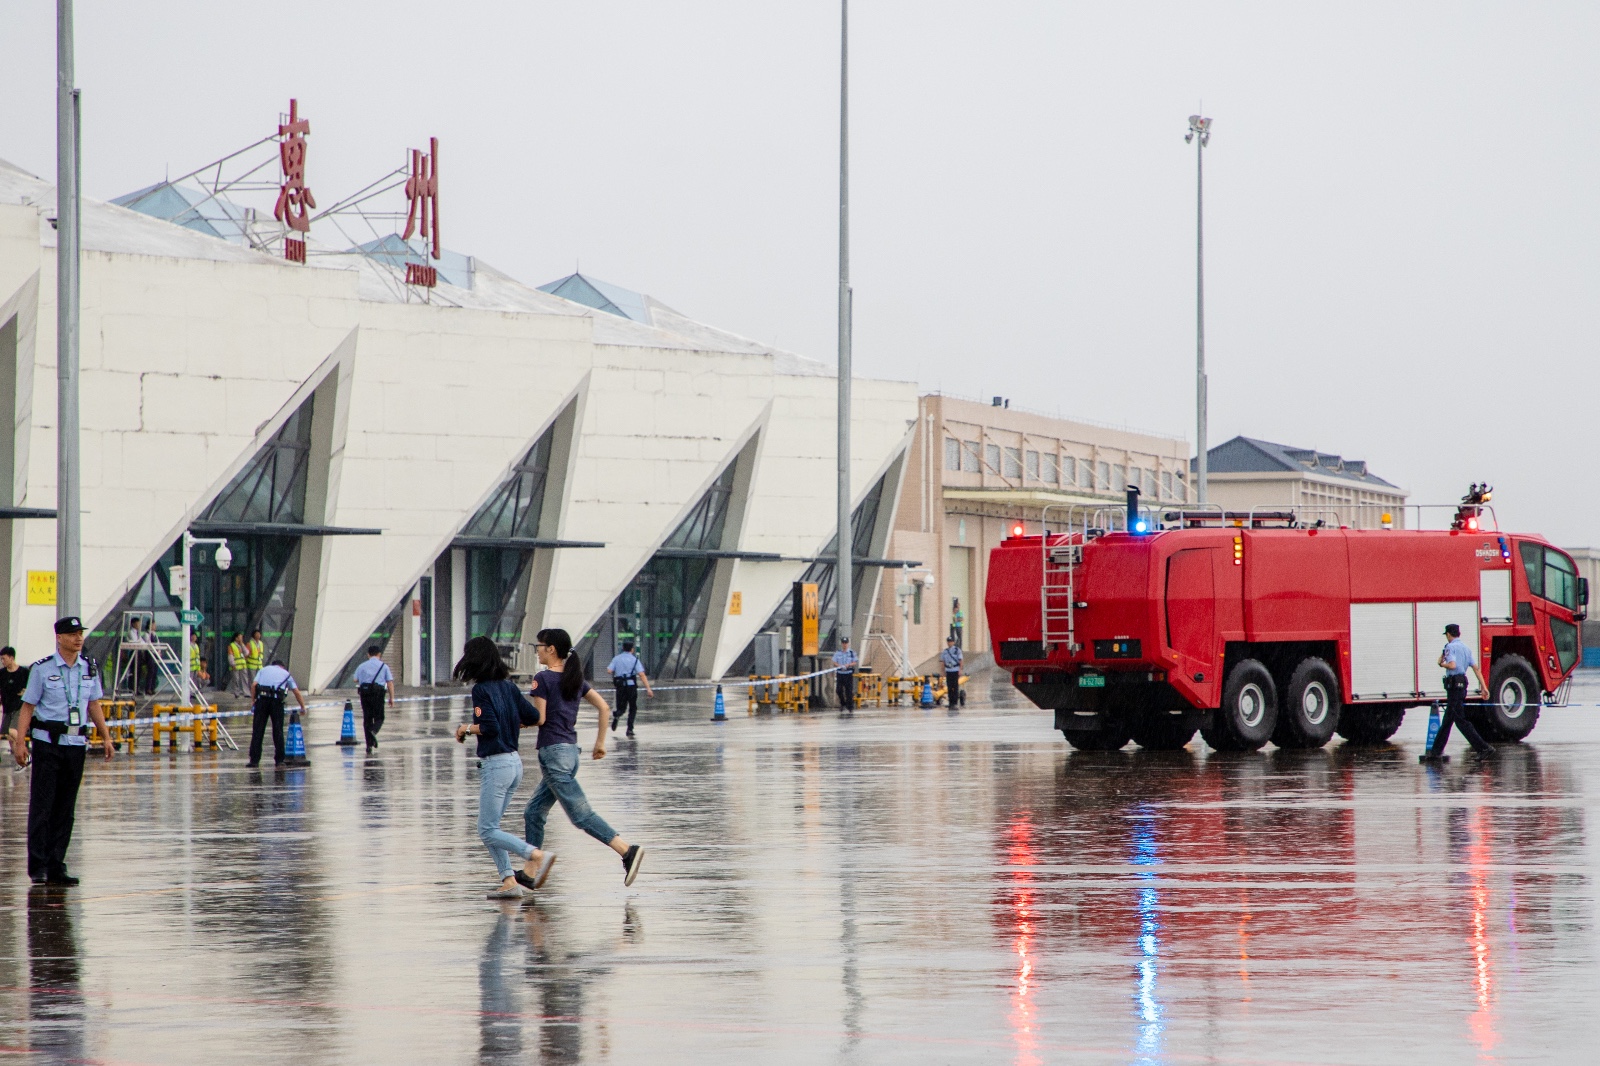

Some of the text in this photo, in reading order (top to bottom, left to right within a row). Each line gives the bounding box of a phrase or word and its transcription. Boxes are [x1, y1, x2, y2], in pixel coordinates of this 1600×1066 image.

[274, 98, 316, 232] 惠
[402, 136, 440, 260] 州
[285, 237, 306, 265] HUI
[405, 262, 437, 288] ZHOU
